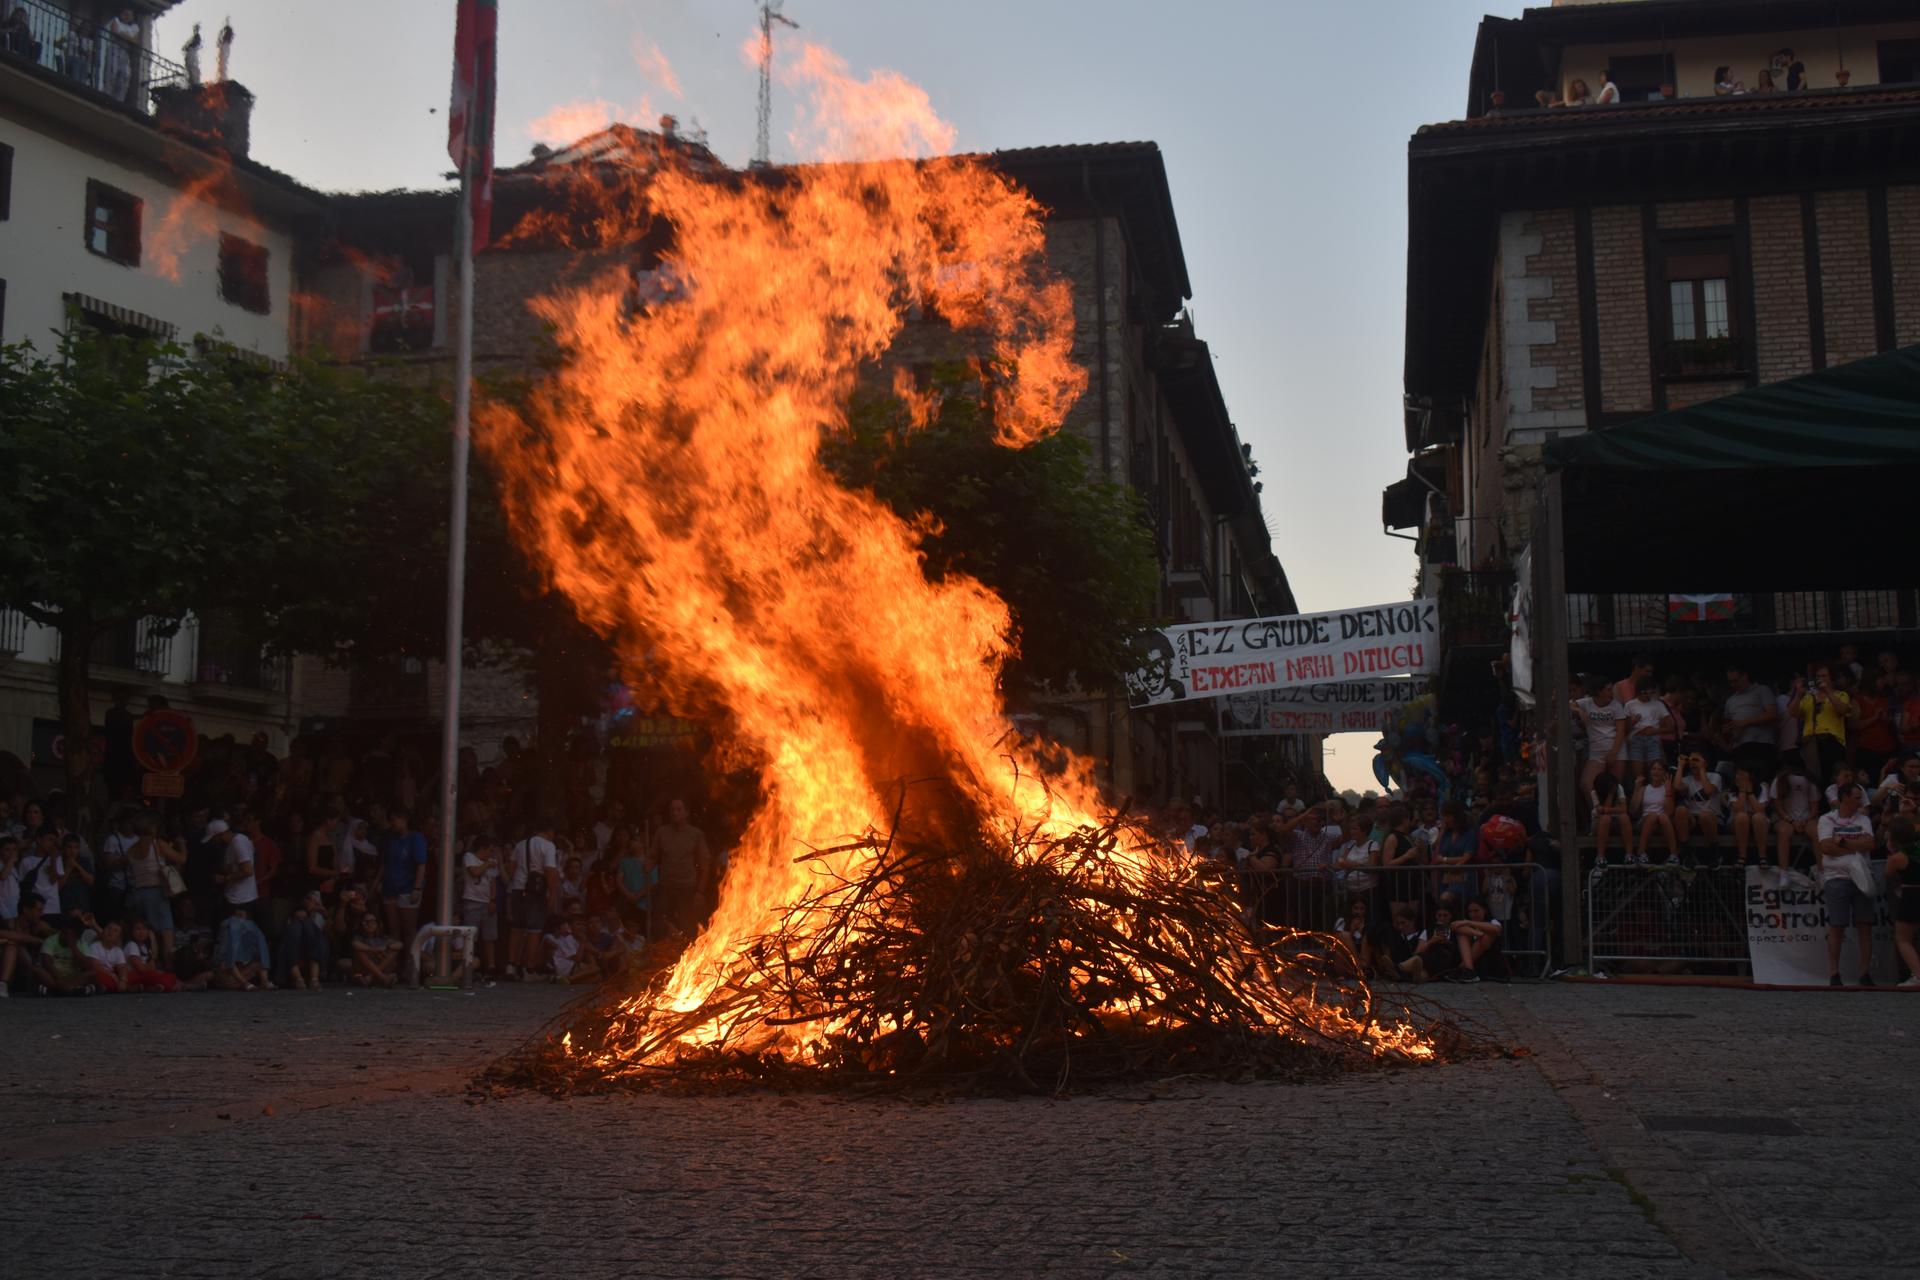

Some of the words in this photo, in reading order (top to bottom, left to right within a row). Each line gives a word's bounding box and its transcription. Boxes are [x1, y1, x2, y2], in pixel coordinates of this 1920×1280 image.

[1188, 626, 1235, 657] EZ
[1242, 617, 1330, 649] GAUDE
[1341, 605, 1435, 640] DENOK
[1176, 633, 1190, 679] GARI
[1192, 662, 1276, 692] ETXEAN
[1286, 654, 1335, 682] NAHI
[1343, 643, 1424, 675] DITUGU
[1271, 685, 1304, 703] EZ
[1310, 682, 1375, 703] GAUDE
[1383, 680, 1426, 702] DEN
[1270, 710, 1333, 729] ETXEAN
[1342, 710, 1377, 729] NAHI
[1747, 884, 1826, 910] Eguzk
